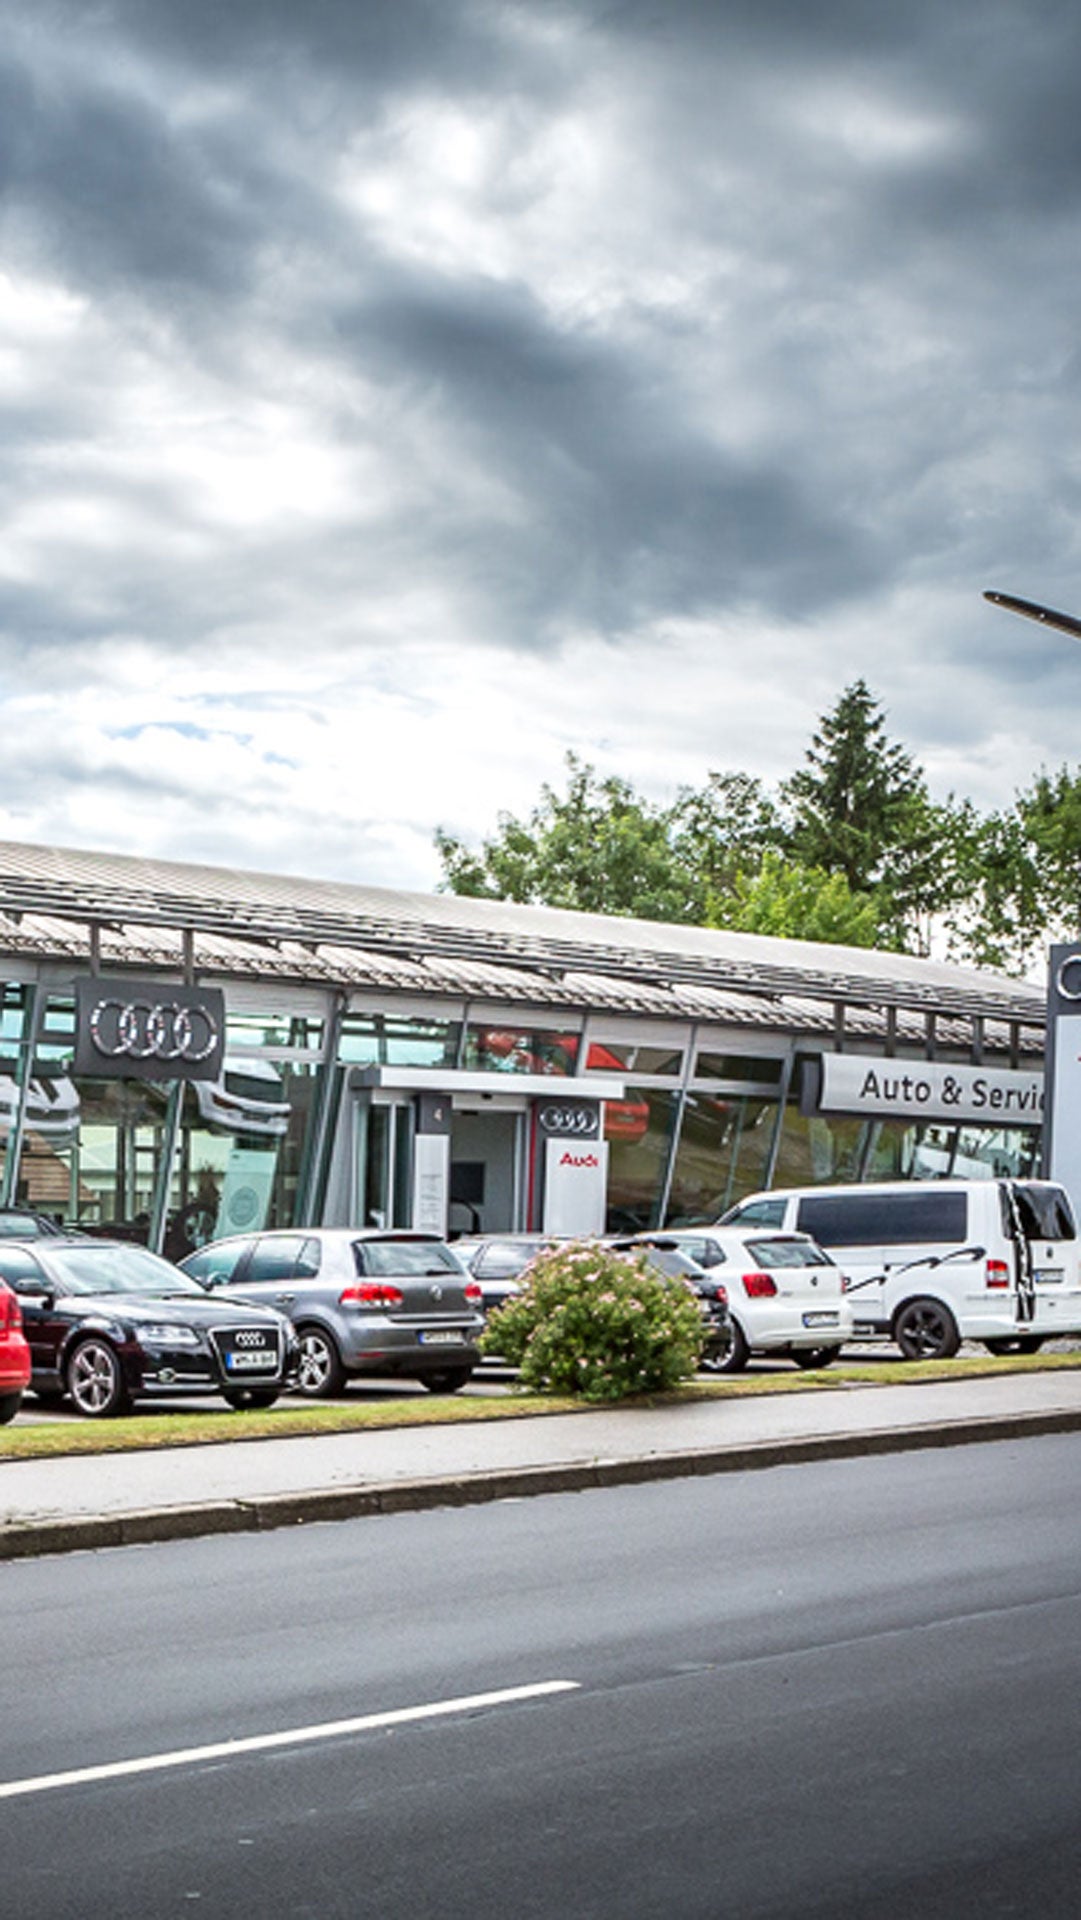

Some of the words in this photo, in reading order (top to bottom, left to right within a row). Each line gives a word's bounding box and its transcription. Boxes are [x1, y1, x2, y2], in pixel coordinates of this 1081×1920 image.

[859, 1069, 932, 1102] Auto
[941, 1075, 963, 1105] &
[559, 1151, 599, 1168] Audi
